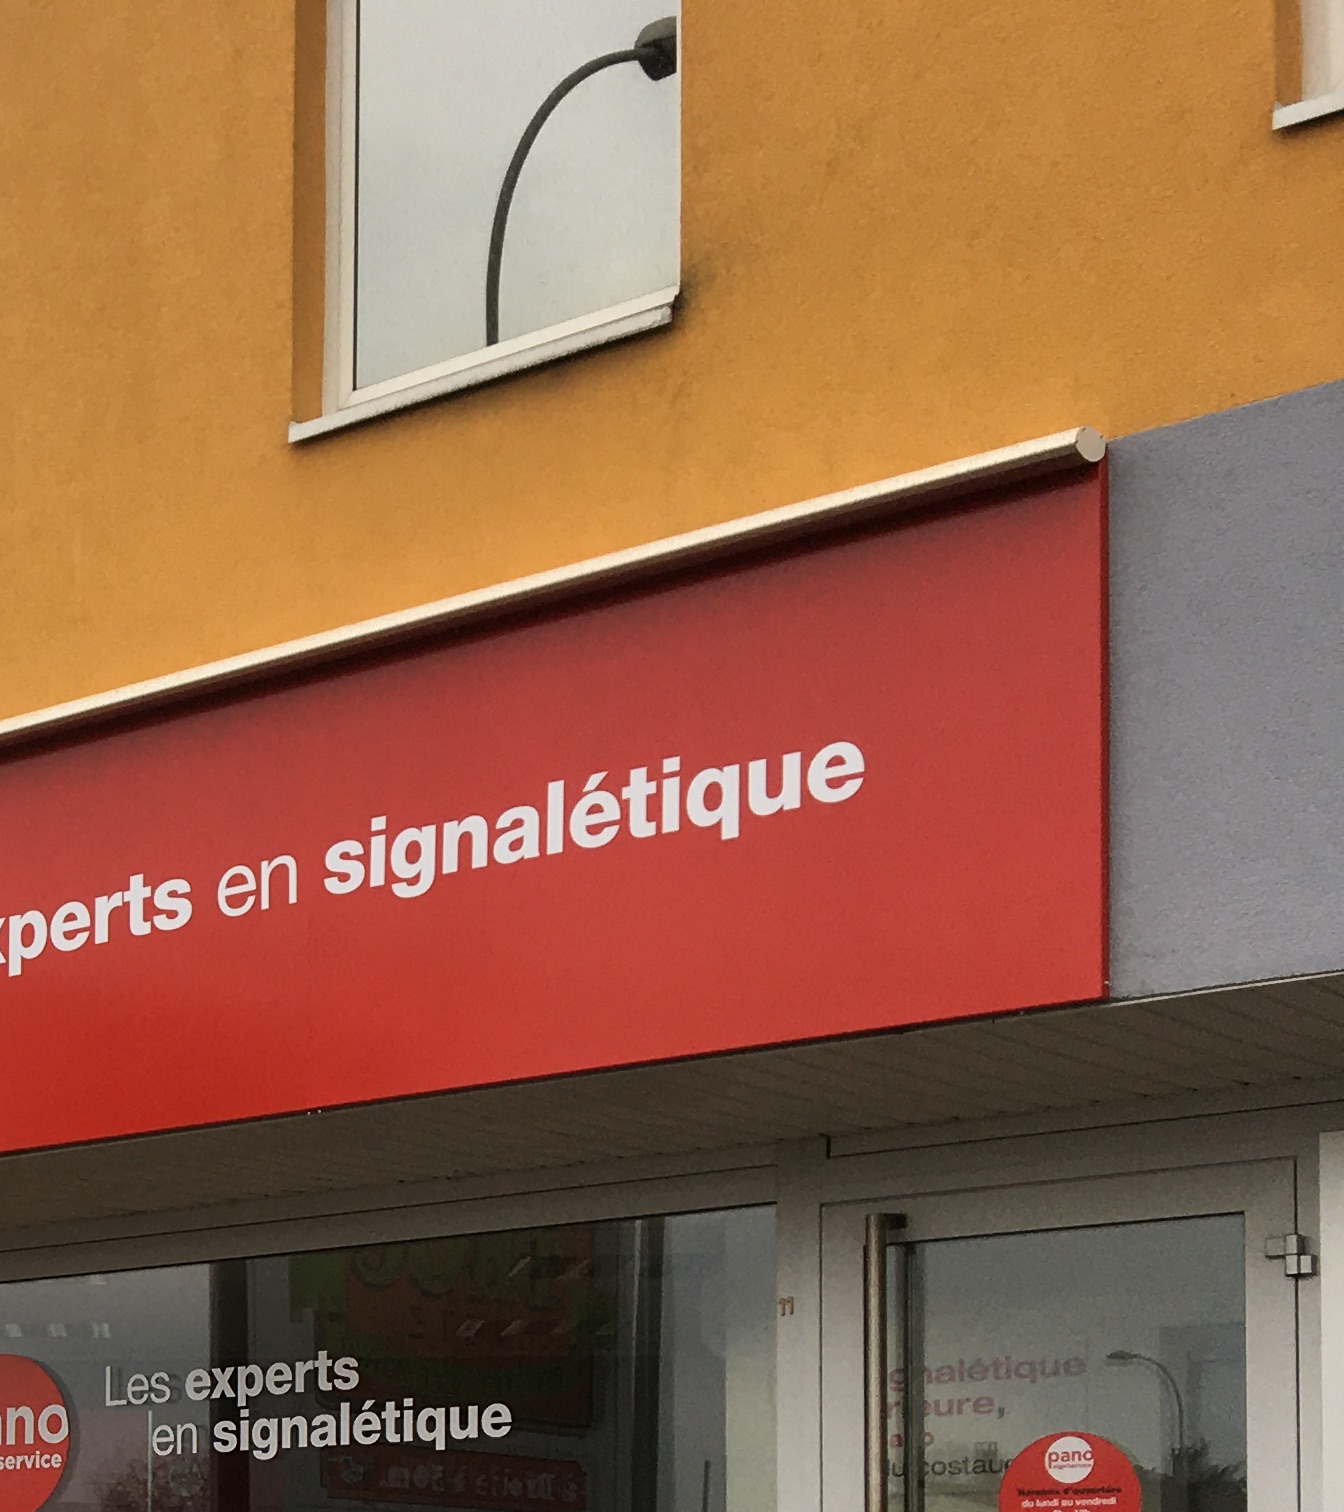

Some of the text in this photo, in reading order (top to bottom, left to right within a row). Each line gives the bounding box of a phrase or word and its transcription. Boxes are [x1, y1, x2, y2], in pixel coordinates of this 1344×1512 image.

[217, 855, 298, 917] en
[323, 741, 866, 898] signalétique
[104, 1350, 359, 1407] Les experts
[152, 1398, 512, 1460] en signalétique
[1047, 1450, 1094, 1468] pano
[1021, 1499, 1034, 1508] du
[1036, 1498, 1059, 1507] lundi
[1075, 1497, 1117, 1506] vendredi
